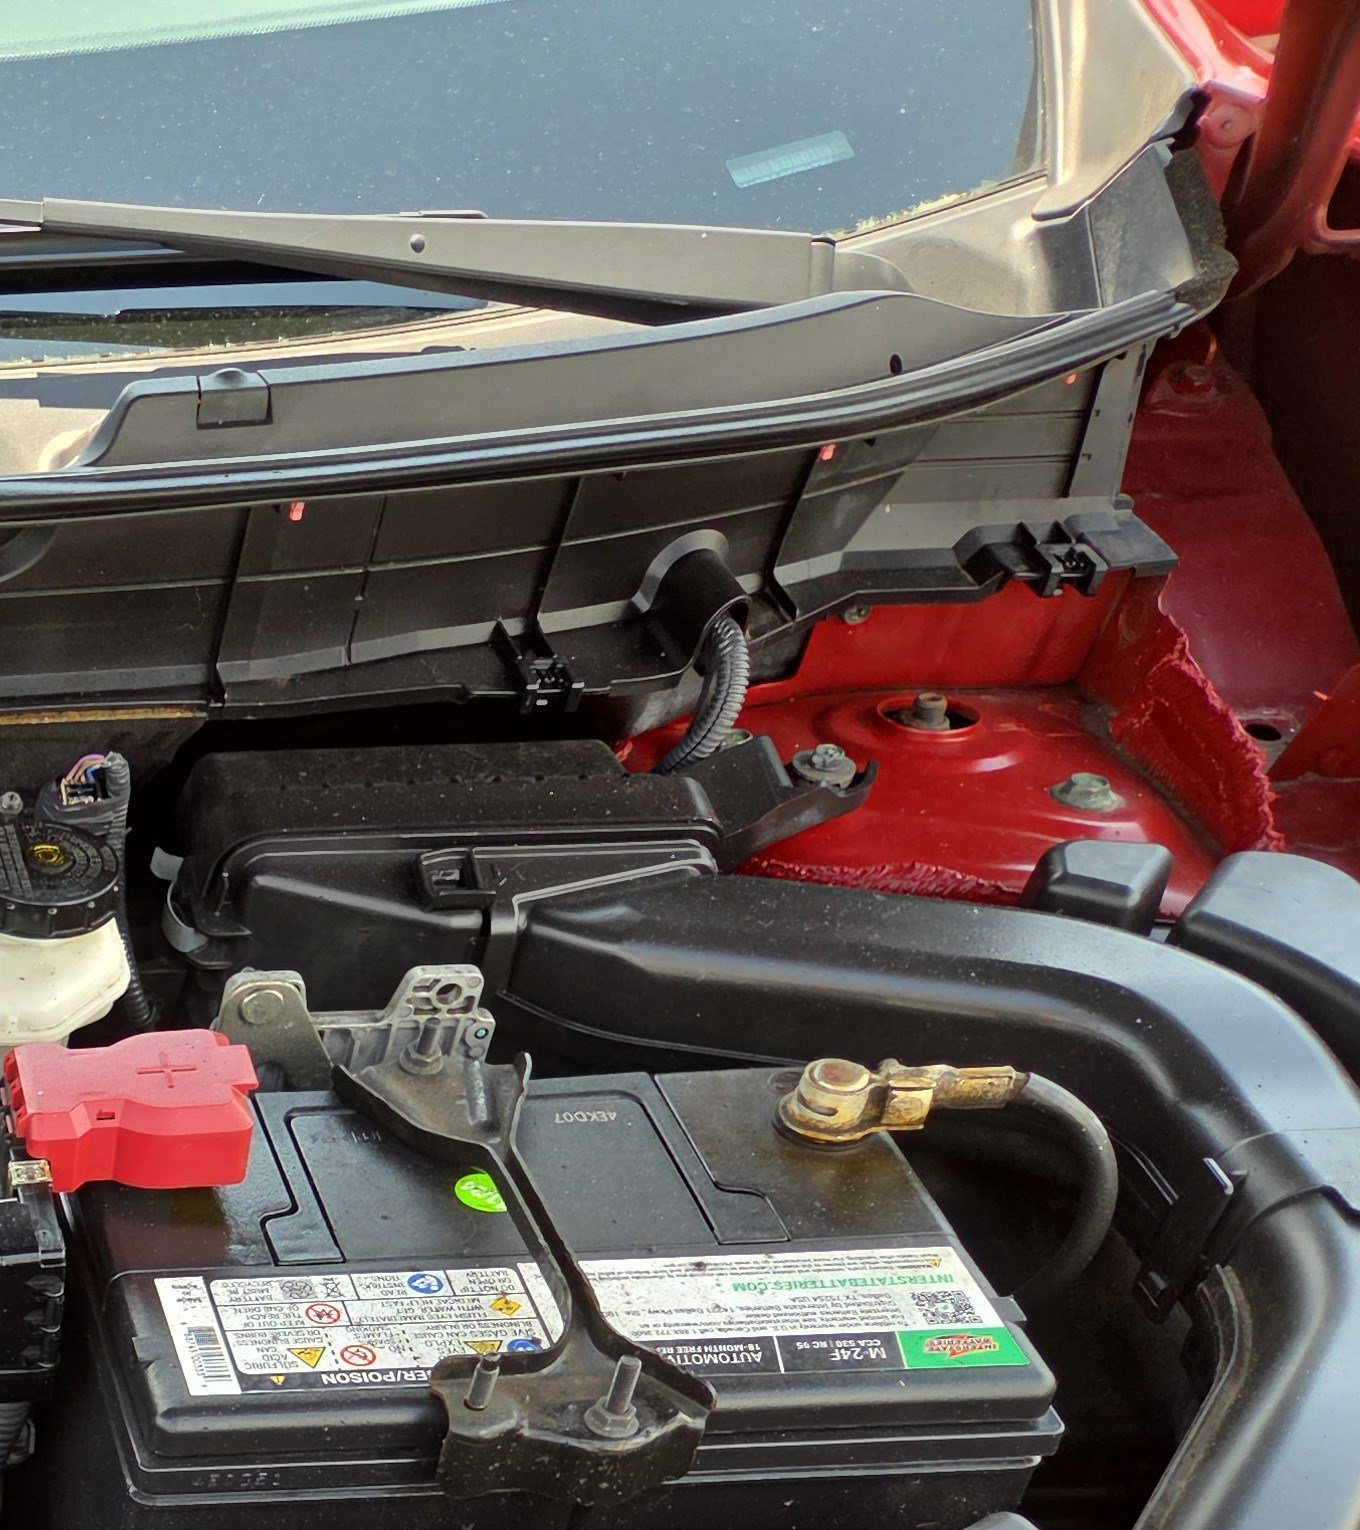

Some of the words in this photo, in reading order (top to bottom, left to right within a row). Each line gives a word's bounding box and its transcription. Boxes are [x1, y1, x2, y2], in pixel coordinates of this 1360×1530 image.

[732, 1274, 952, 1291] INTERSTATEBATTERIES.COM
[292, 1336, 323, 1344] CAUSE
[388, 1344, 405, 1354] NO
[261, 1353, 288, 1361] ACID
